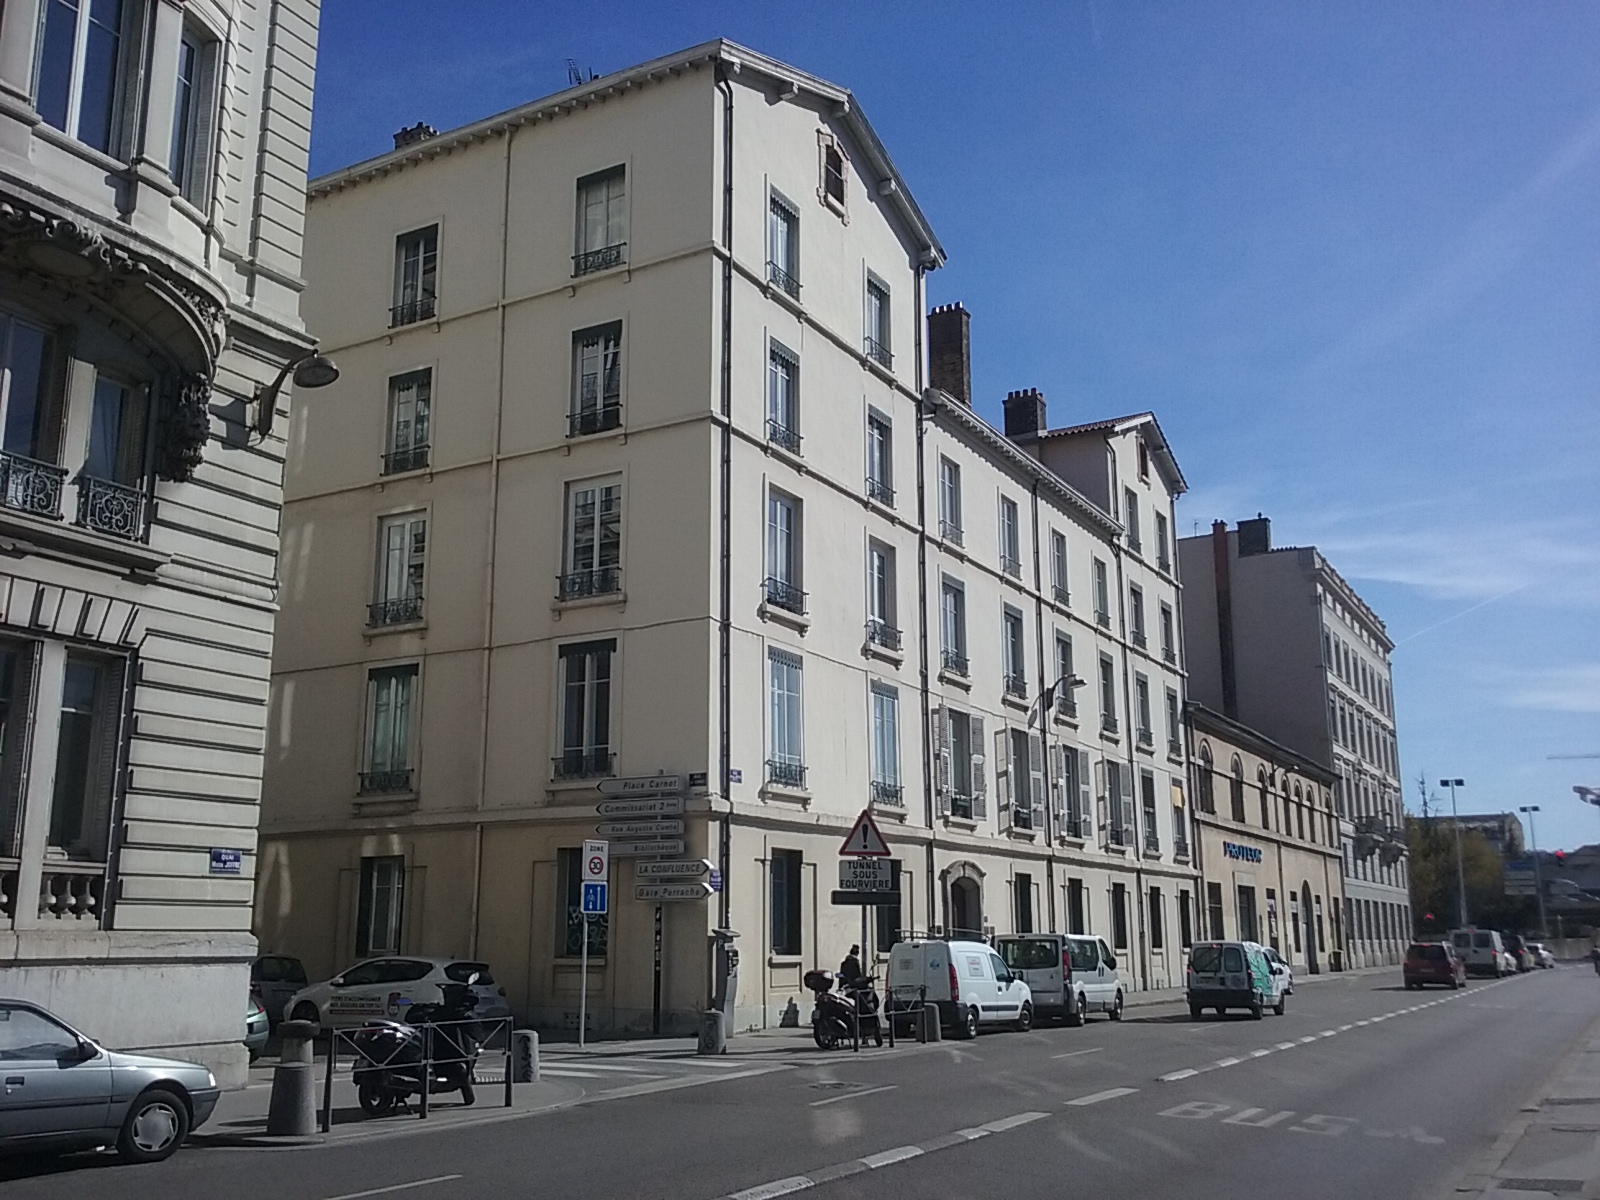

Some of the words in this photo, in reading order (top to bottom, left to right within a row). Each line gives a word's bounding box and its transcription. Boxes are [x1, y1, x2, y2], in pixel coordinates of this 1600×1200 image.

[623, 781, 645, 790] Place
[649, 780, 677, 788] Carnot
[604, 803, 656, 813] Commissariat
[626, 825, 653, 833] Auguste
[592, 861, 601, 870] 30
[651, 864, 700, 873] CONFLUENCE
[847, 861, 883, 870] TUNNEL
[852, 870, 878, 879] SOUS
[639, 888, 659, 897] Gare
[662, 887, 700, 896] Perrache
[1156, 1101, 1360, 1136] BUS
